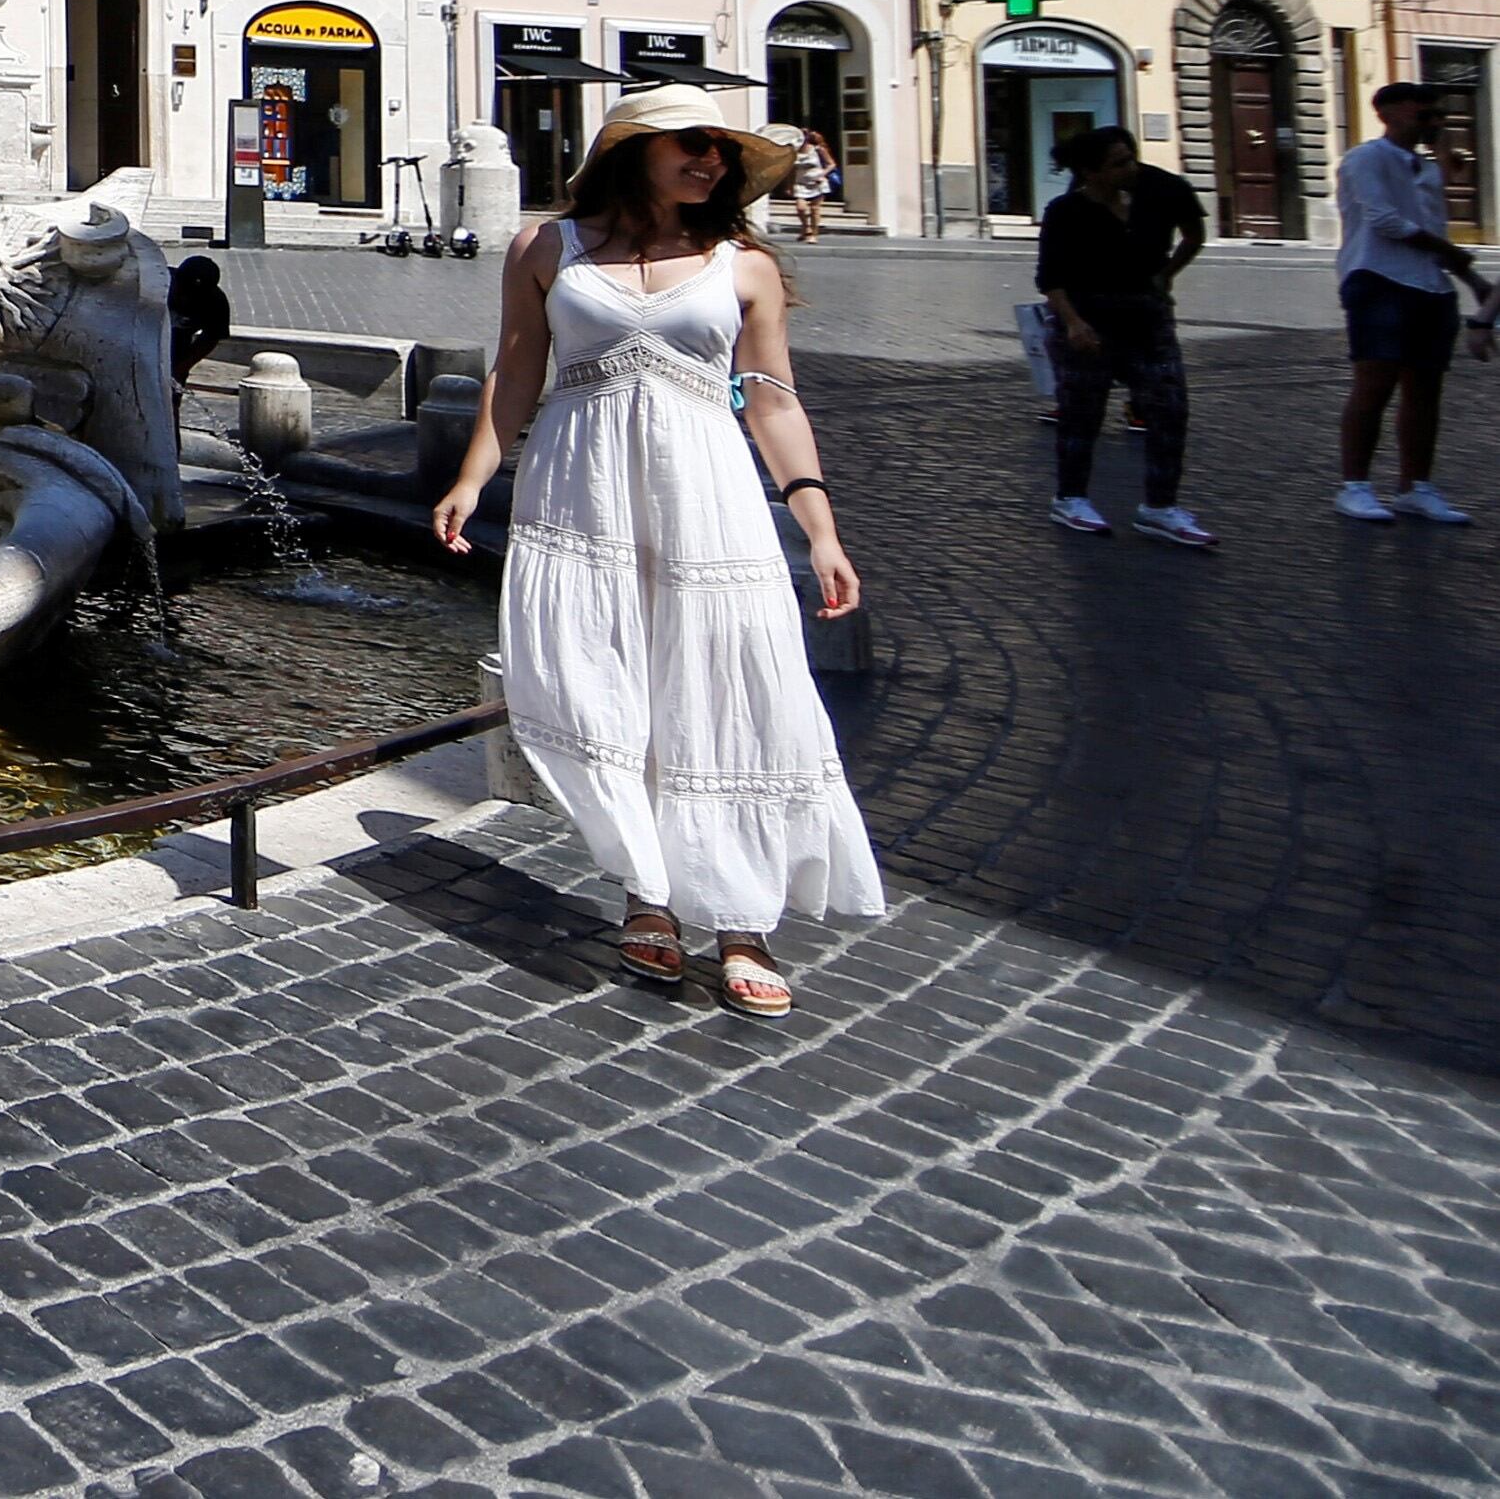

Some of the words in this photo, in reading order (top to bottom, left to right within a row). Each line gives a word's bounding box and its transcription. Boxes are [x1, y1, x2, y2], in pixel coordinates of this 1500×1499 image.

[256, 22, 302, 35] ACQUA
[320, 26, 365, 39] PARMA
[523, 28, 552, 43] IWC
[647, 35, 677, 50] IWC
[1013, 37, 1078, 54] FARMACIA
